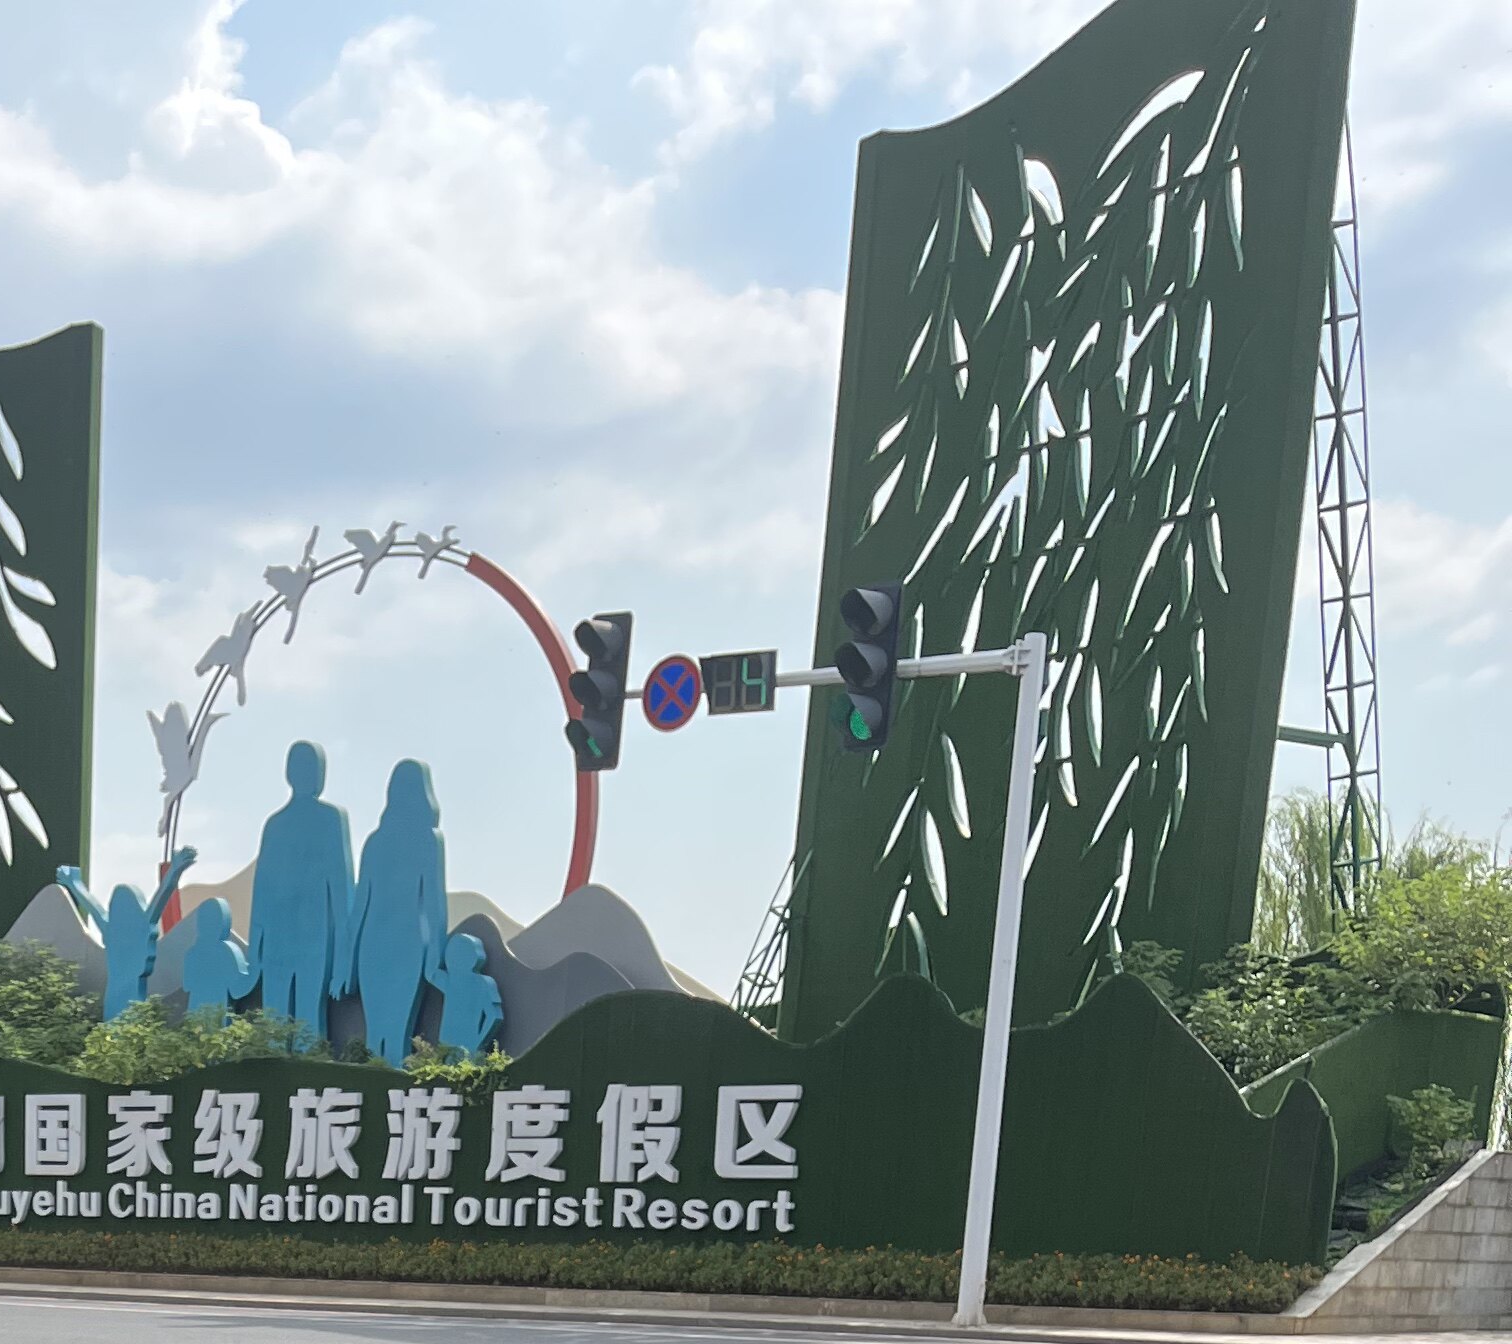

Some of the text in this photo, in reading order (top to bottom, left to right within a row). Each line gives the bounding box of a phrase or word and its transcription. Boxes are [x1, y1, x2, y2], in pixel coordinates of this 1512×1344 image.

[108, 1181, 222, 1220] China
[228, 1184, 414, 1224] National
[423, 1186, 604, 1227] Tourist
[612, 1188, 796, 1232] Resort
